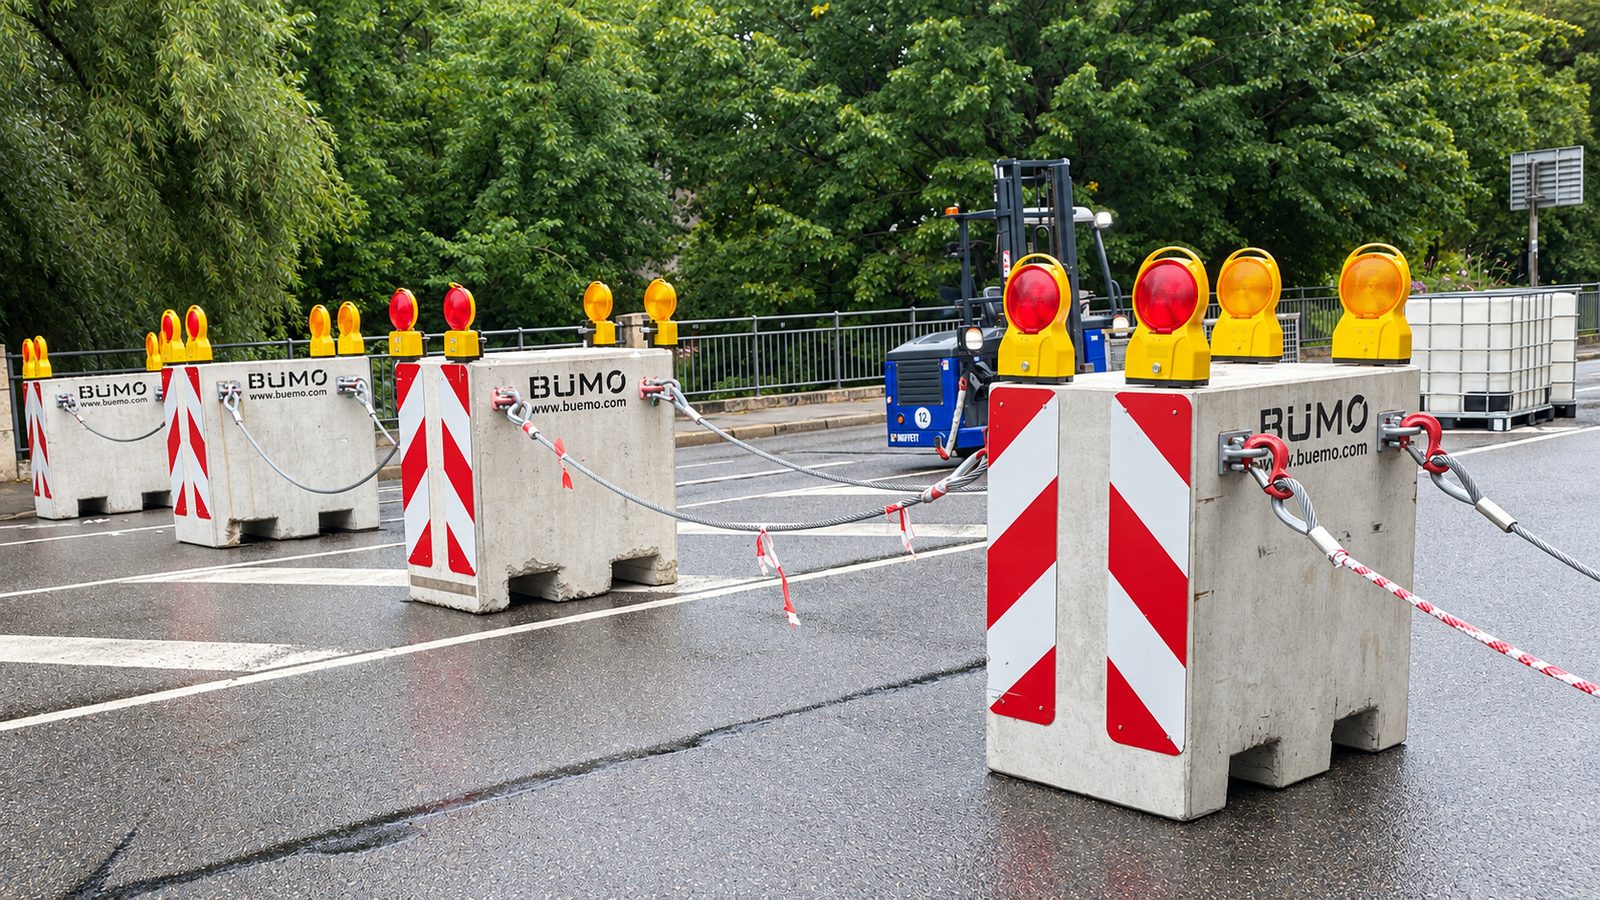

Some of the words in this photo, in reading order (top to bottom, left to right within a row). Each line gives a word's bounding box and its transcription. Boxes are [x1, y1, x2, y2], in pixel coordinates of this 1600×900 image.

[247, 368, 328, 389] BÜMO
[529, 369, 626, 399] BÜMO
[78, 381, 147, 399] BÜMO
[249, 389, 327, 400] www.buemo.com
[80, 397, 148, 407] www.buemo.com
[531, 398, 626, 414] www.buemo.com
[918, 412, 928, 422] 12
[1260, 394, 1368, 442] BÜMO
